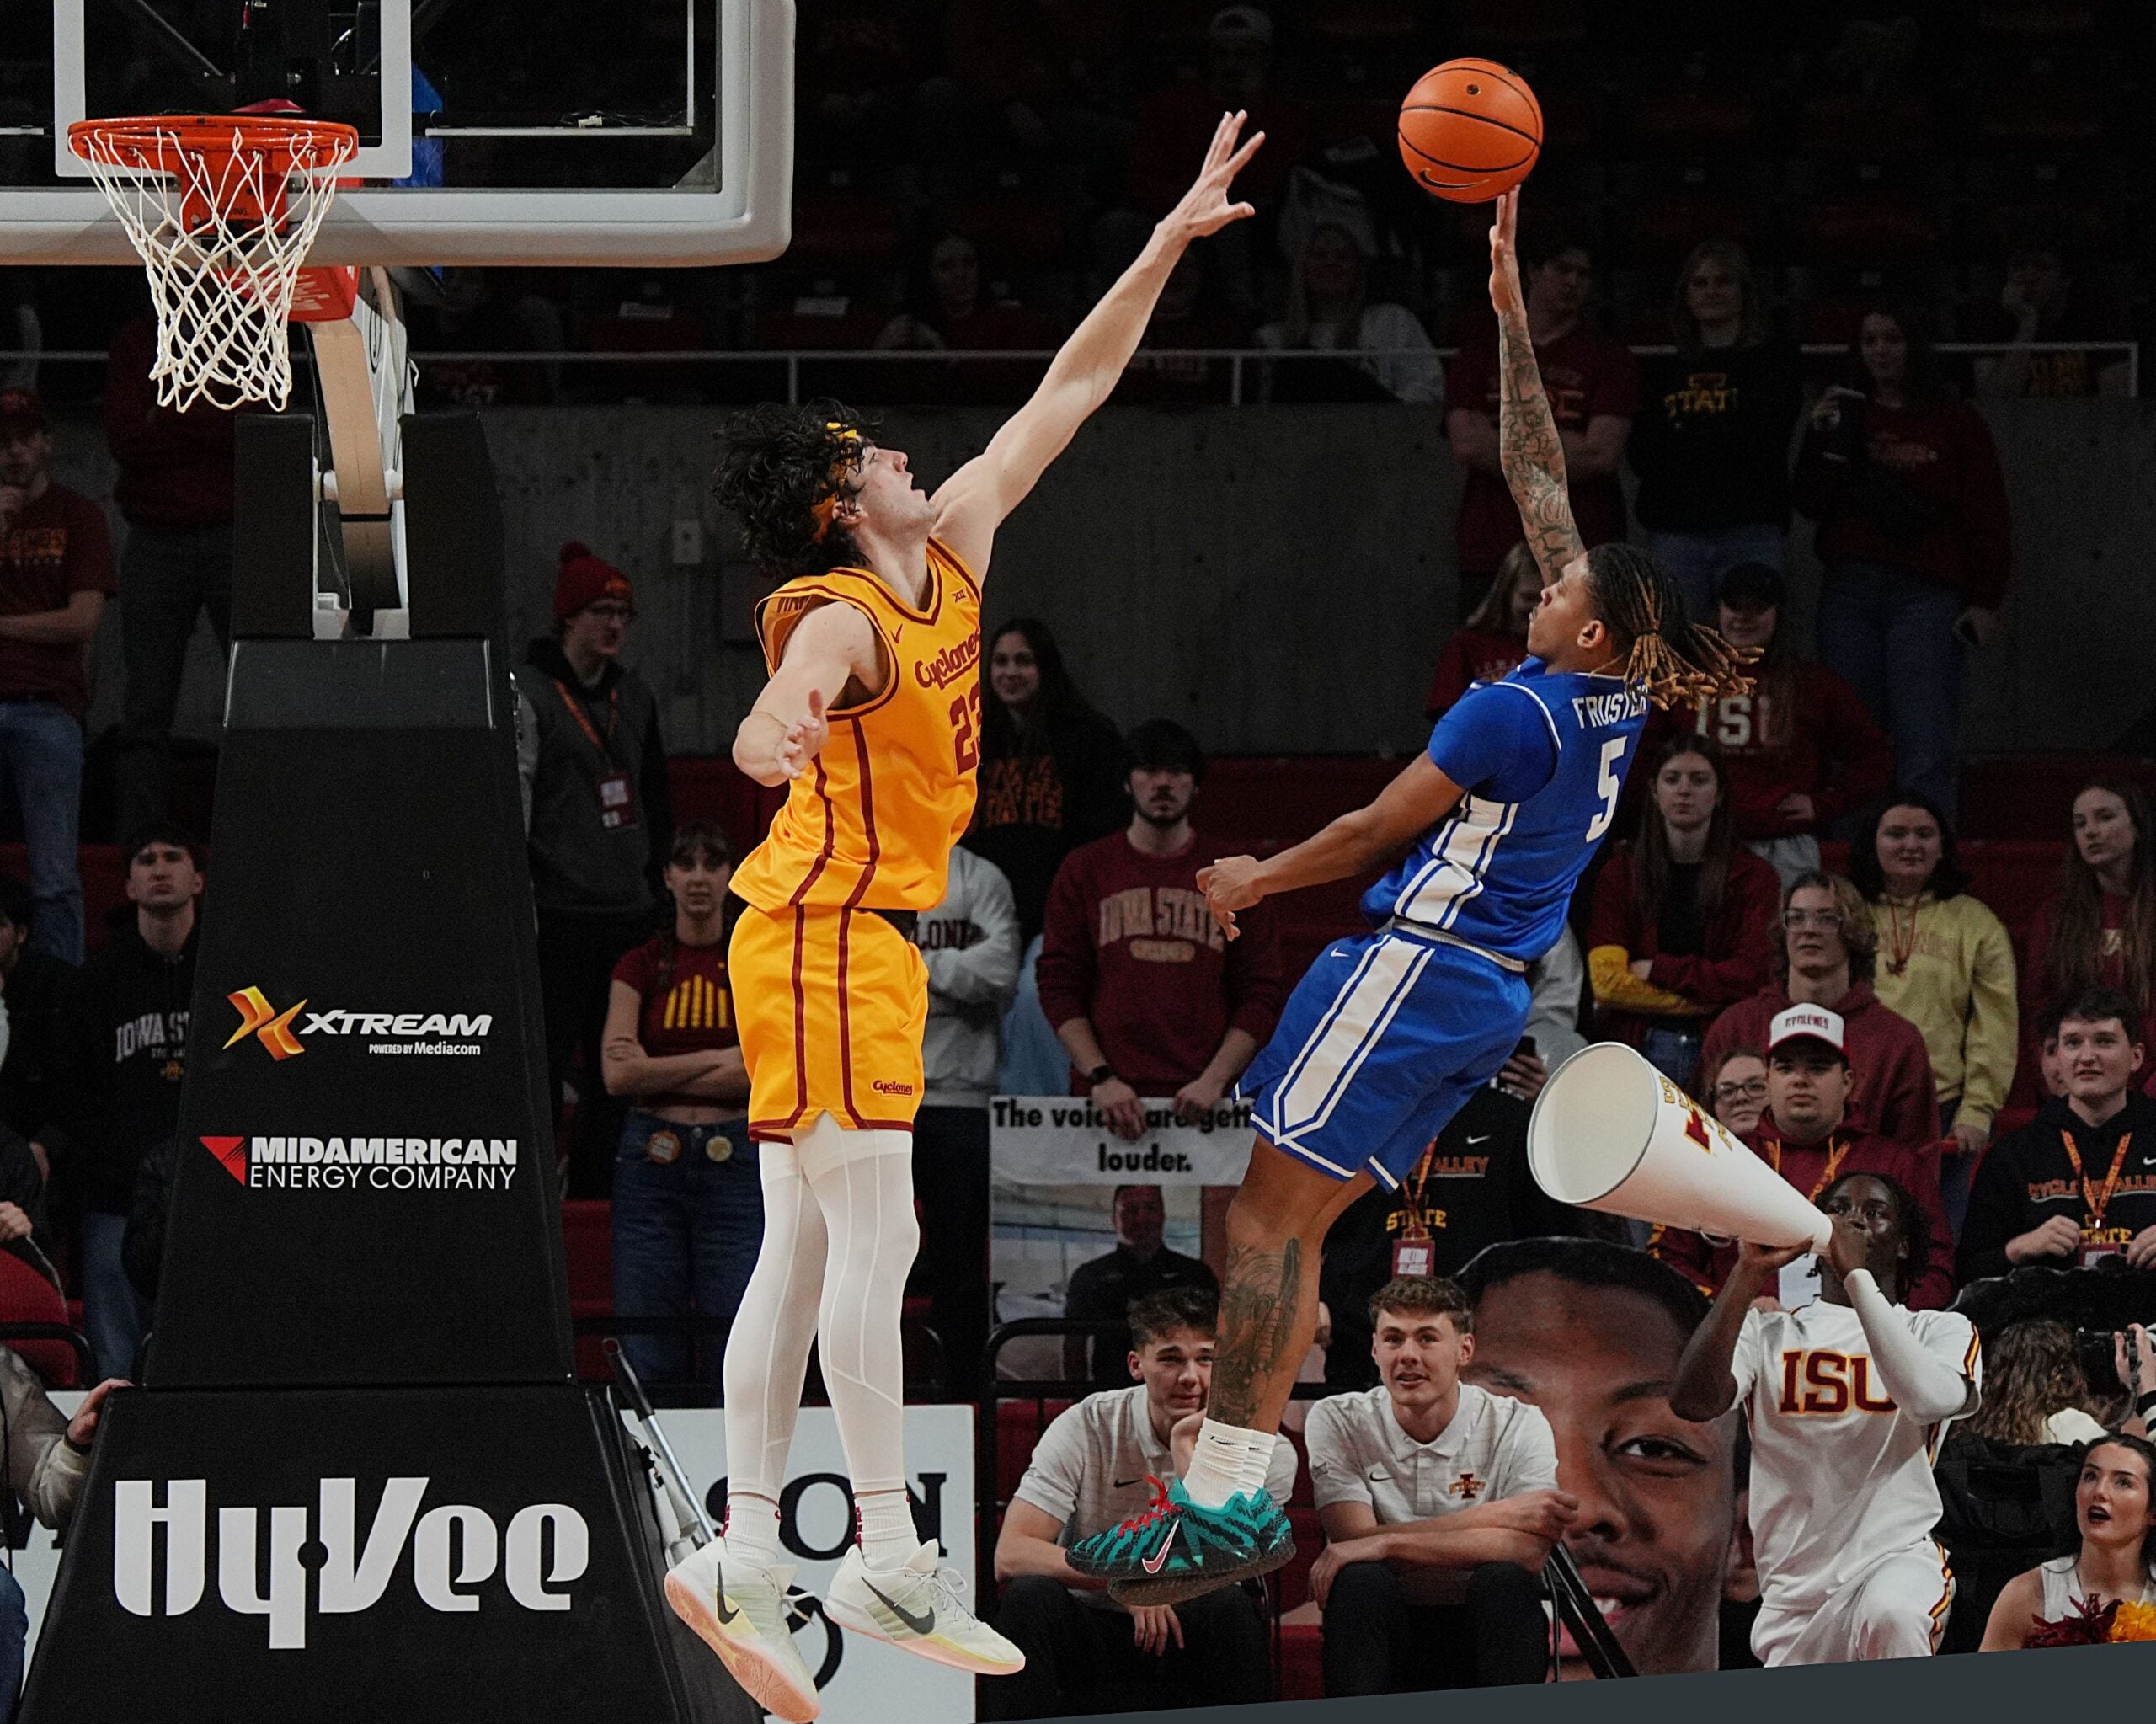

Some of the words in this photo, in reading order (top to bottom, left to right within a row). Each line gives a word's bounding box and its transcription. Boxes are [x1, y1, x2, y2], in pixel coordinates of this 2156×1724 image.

[1586, 735, 1629, 843] 5
[115, 1011, 166, 1063] IOWA
[169, 1011, 189, 1043] S
[369, 1043, 402, 1054] POWERED
[403, 1043, 413, 1054] BY
[414, 1041, 481, 1055] Mediacom
[873, 1080, 912, 1096] Cyclones
[993, 1100, 1042, 1127] The
[251, 1137, 517, 1165] MIDAMERICAN
[1099, 1144, 1192, 1172] louder.
[250, 1166, 362, 1188] ENERGY
[369, 1166, 516, 1189] COMPANY
[115, 1476, 590, 1650] HyVee
